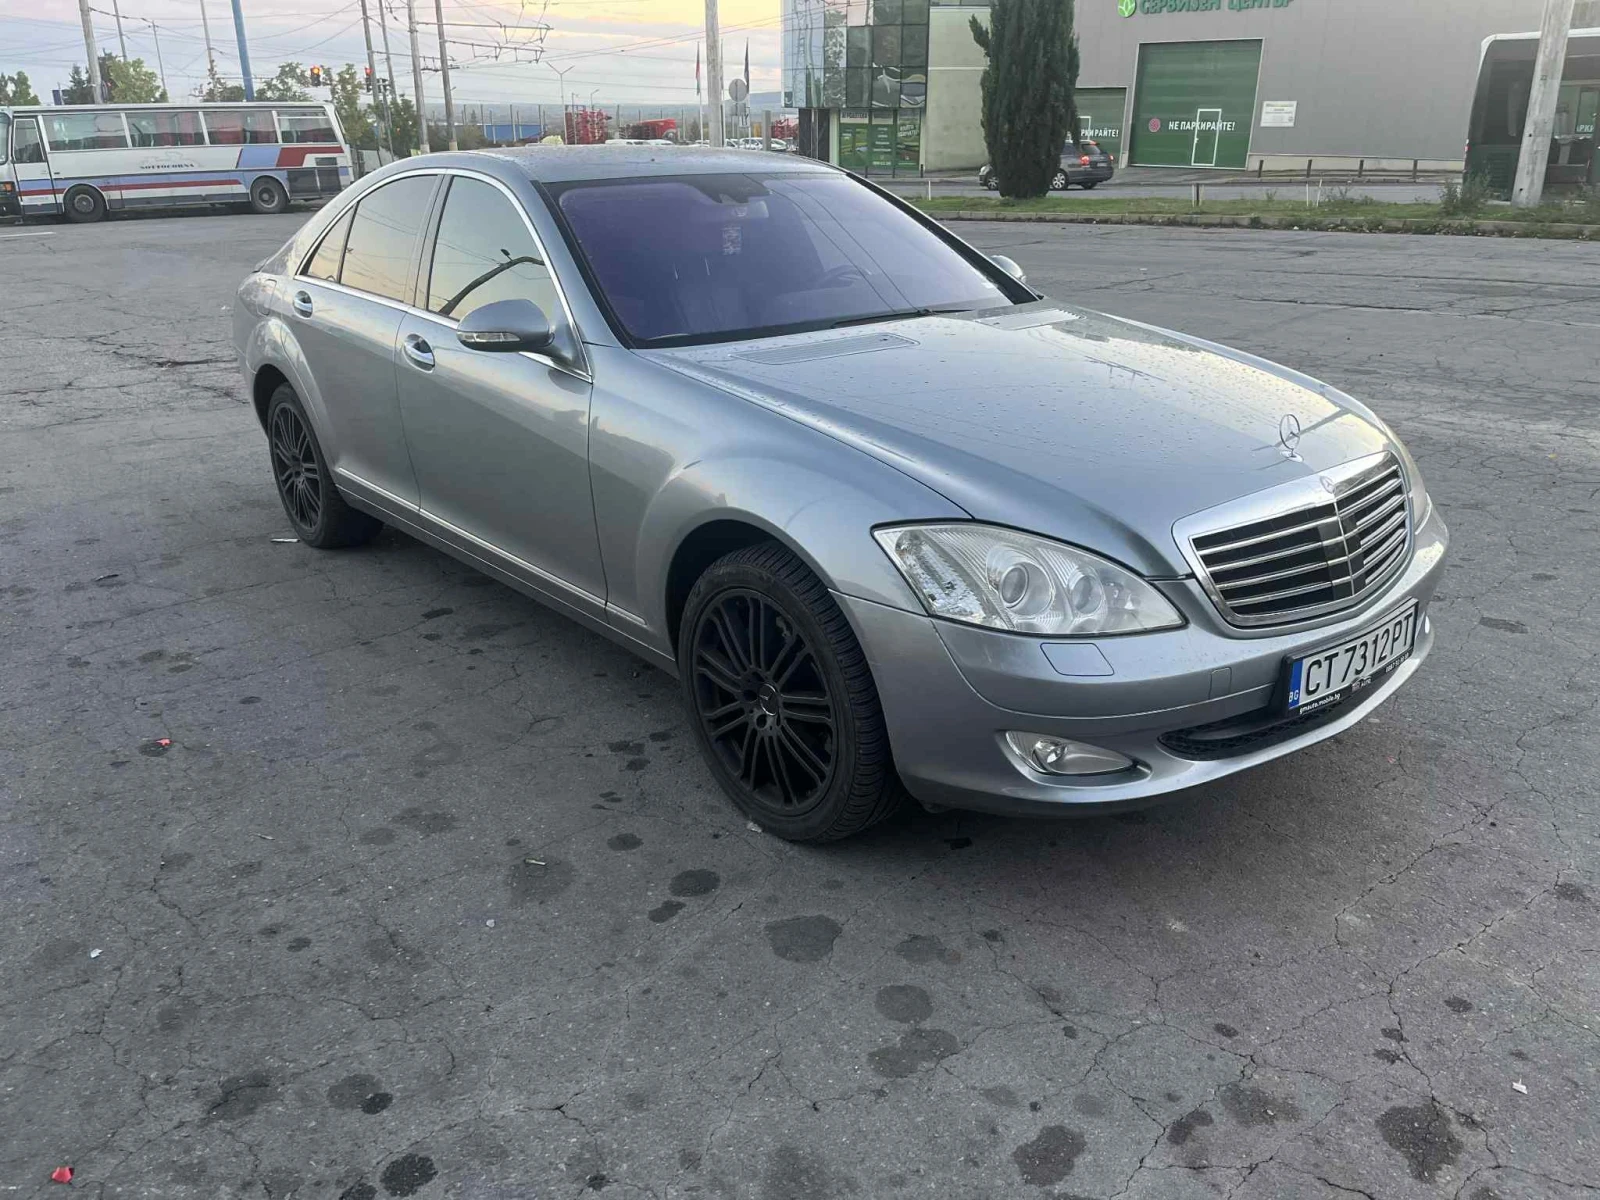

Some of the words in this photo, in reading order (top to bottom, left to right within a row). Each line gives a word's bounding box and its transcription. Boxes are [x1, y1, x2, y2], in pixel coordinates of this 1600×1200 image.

[1168, 121, 1180, 130] НЕ
[1080, 127, 1119, 137] РКИРАЙТЕ!
[1288, 689, 1299, 703] BG
